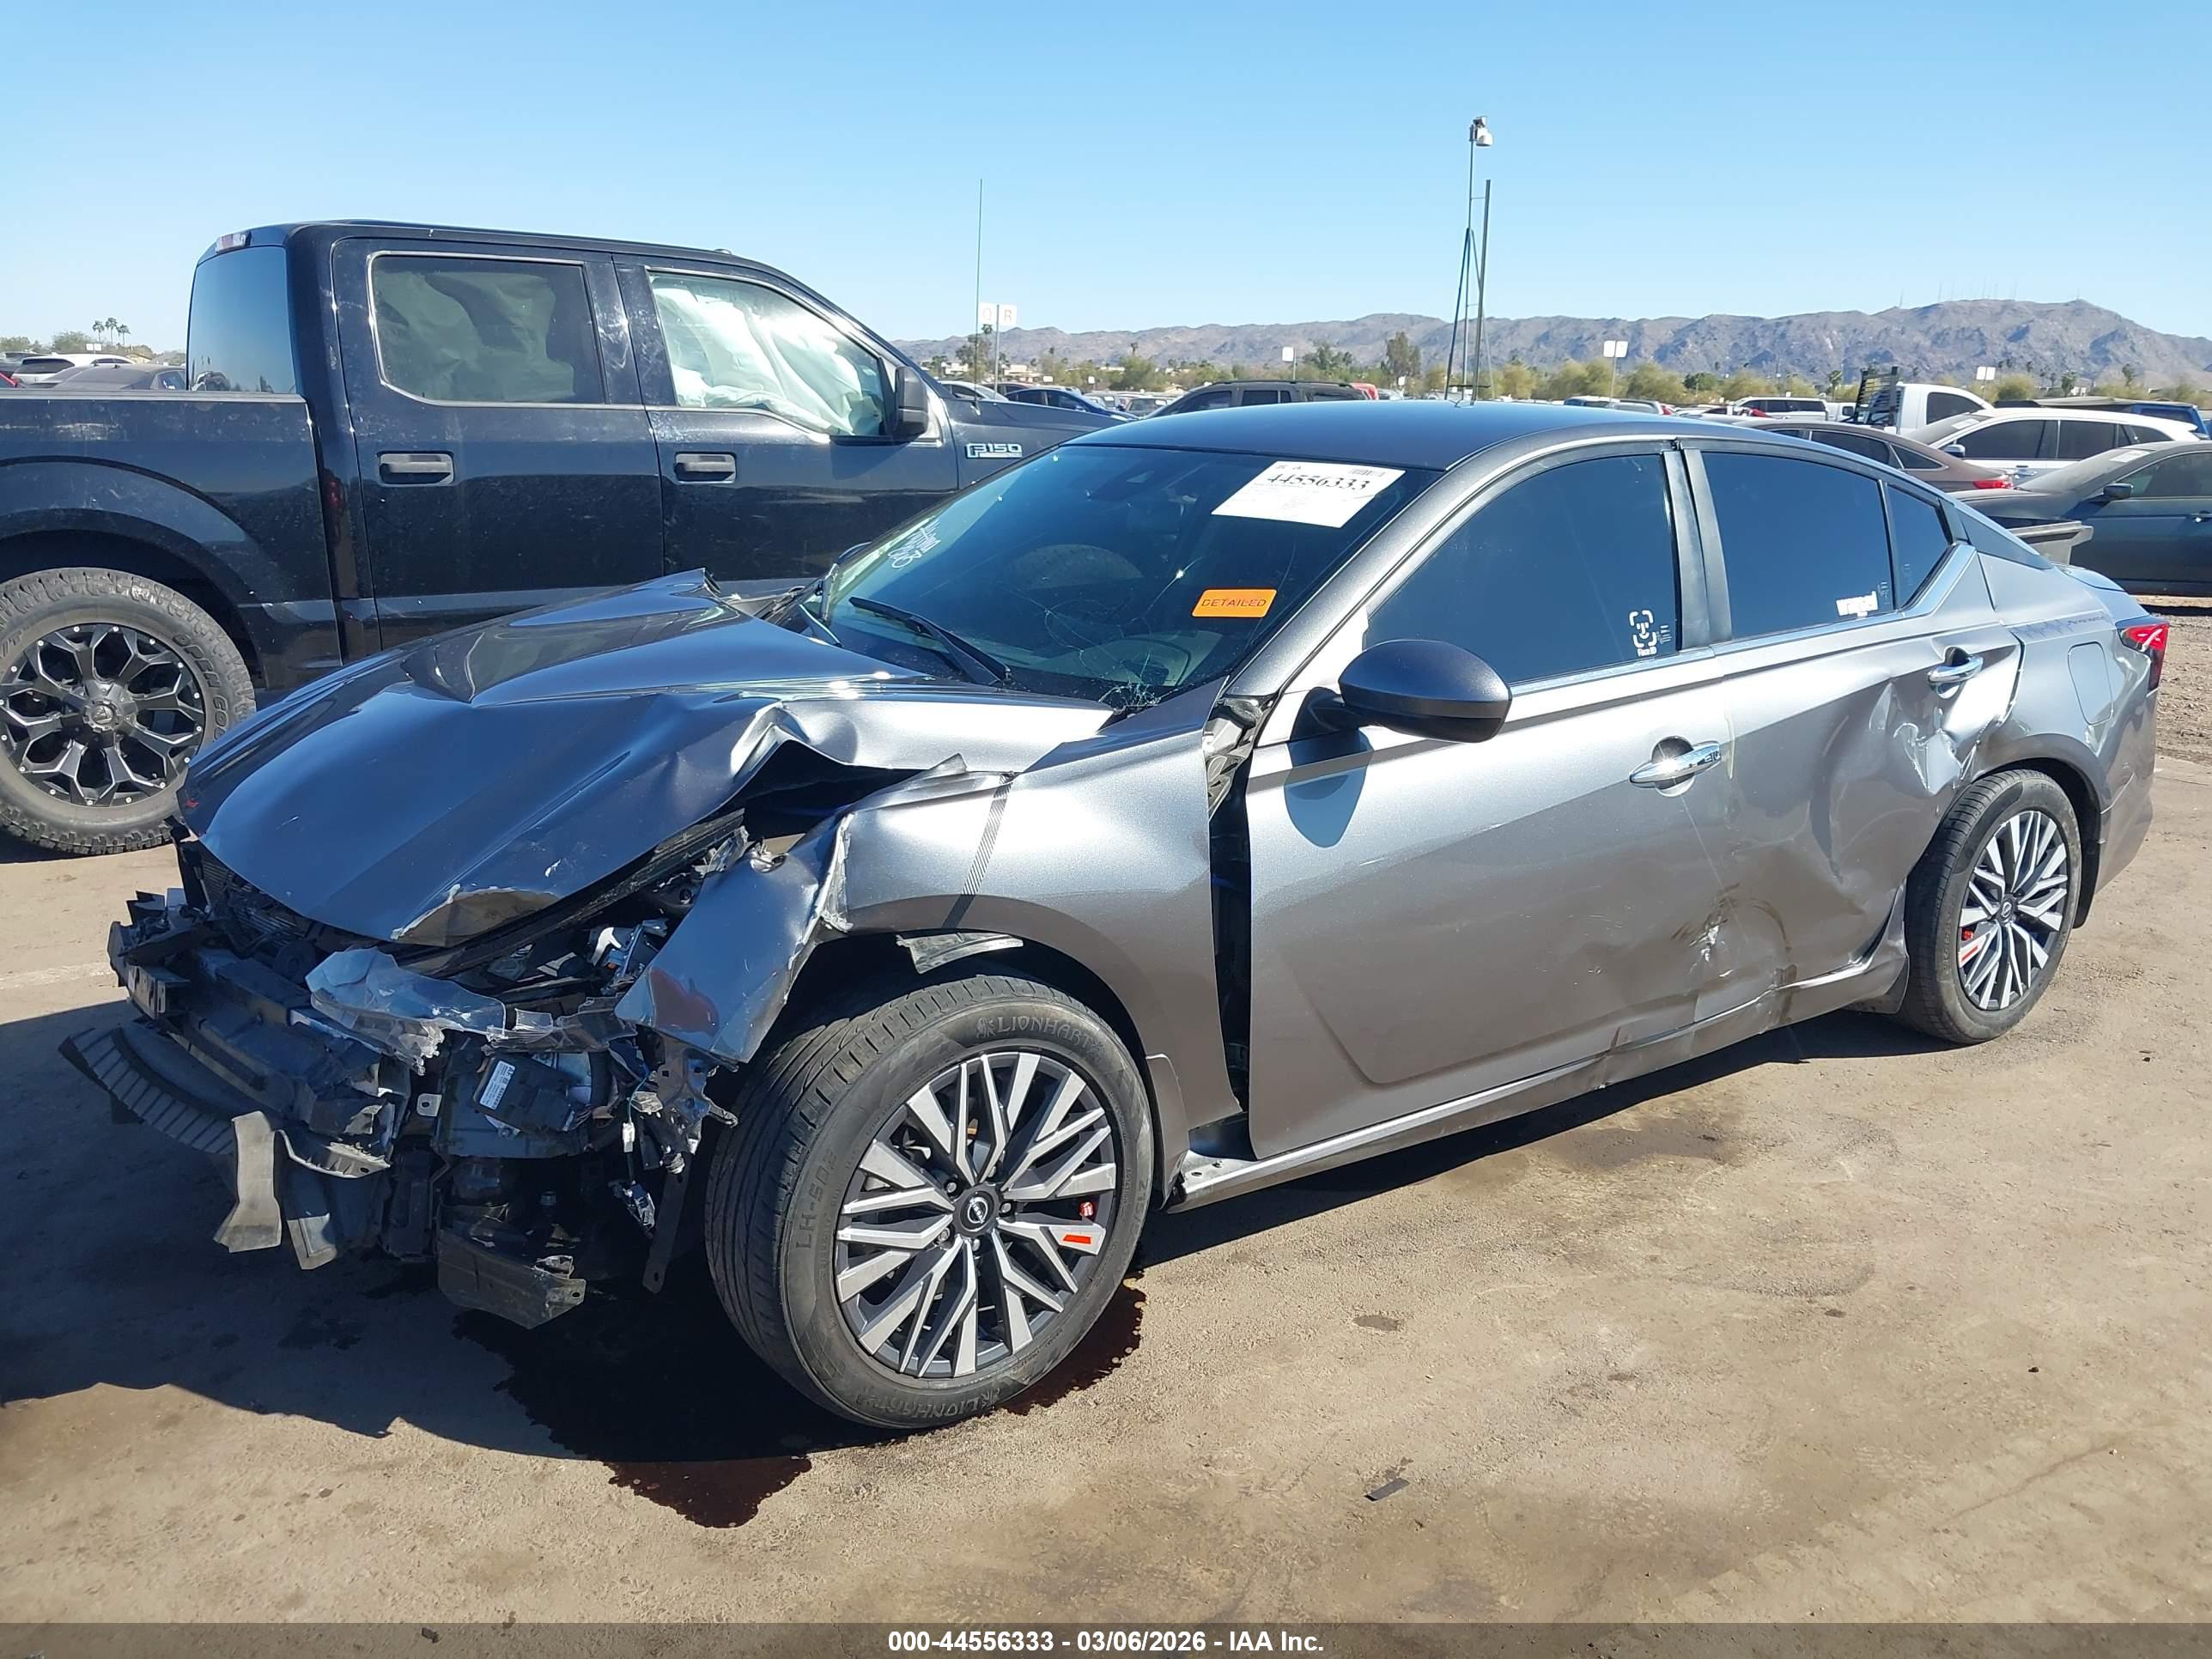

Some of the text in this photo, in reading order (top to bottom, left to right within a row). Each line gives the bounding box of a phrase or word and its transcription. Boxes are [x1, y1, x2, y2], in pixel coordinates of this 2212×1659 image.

[1004, 309, 1012, 322] R
[1267, 473, 1371, 492] 44556333
[1200, 598, 1267, 607] DETAILED
[171, 634, 222, 689] OPEN
[997, 1013, 1094, 1048] LIONHART
